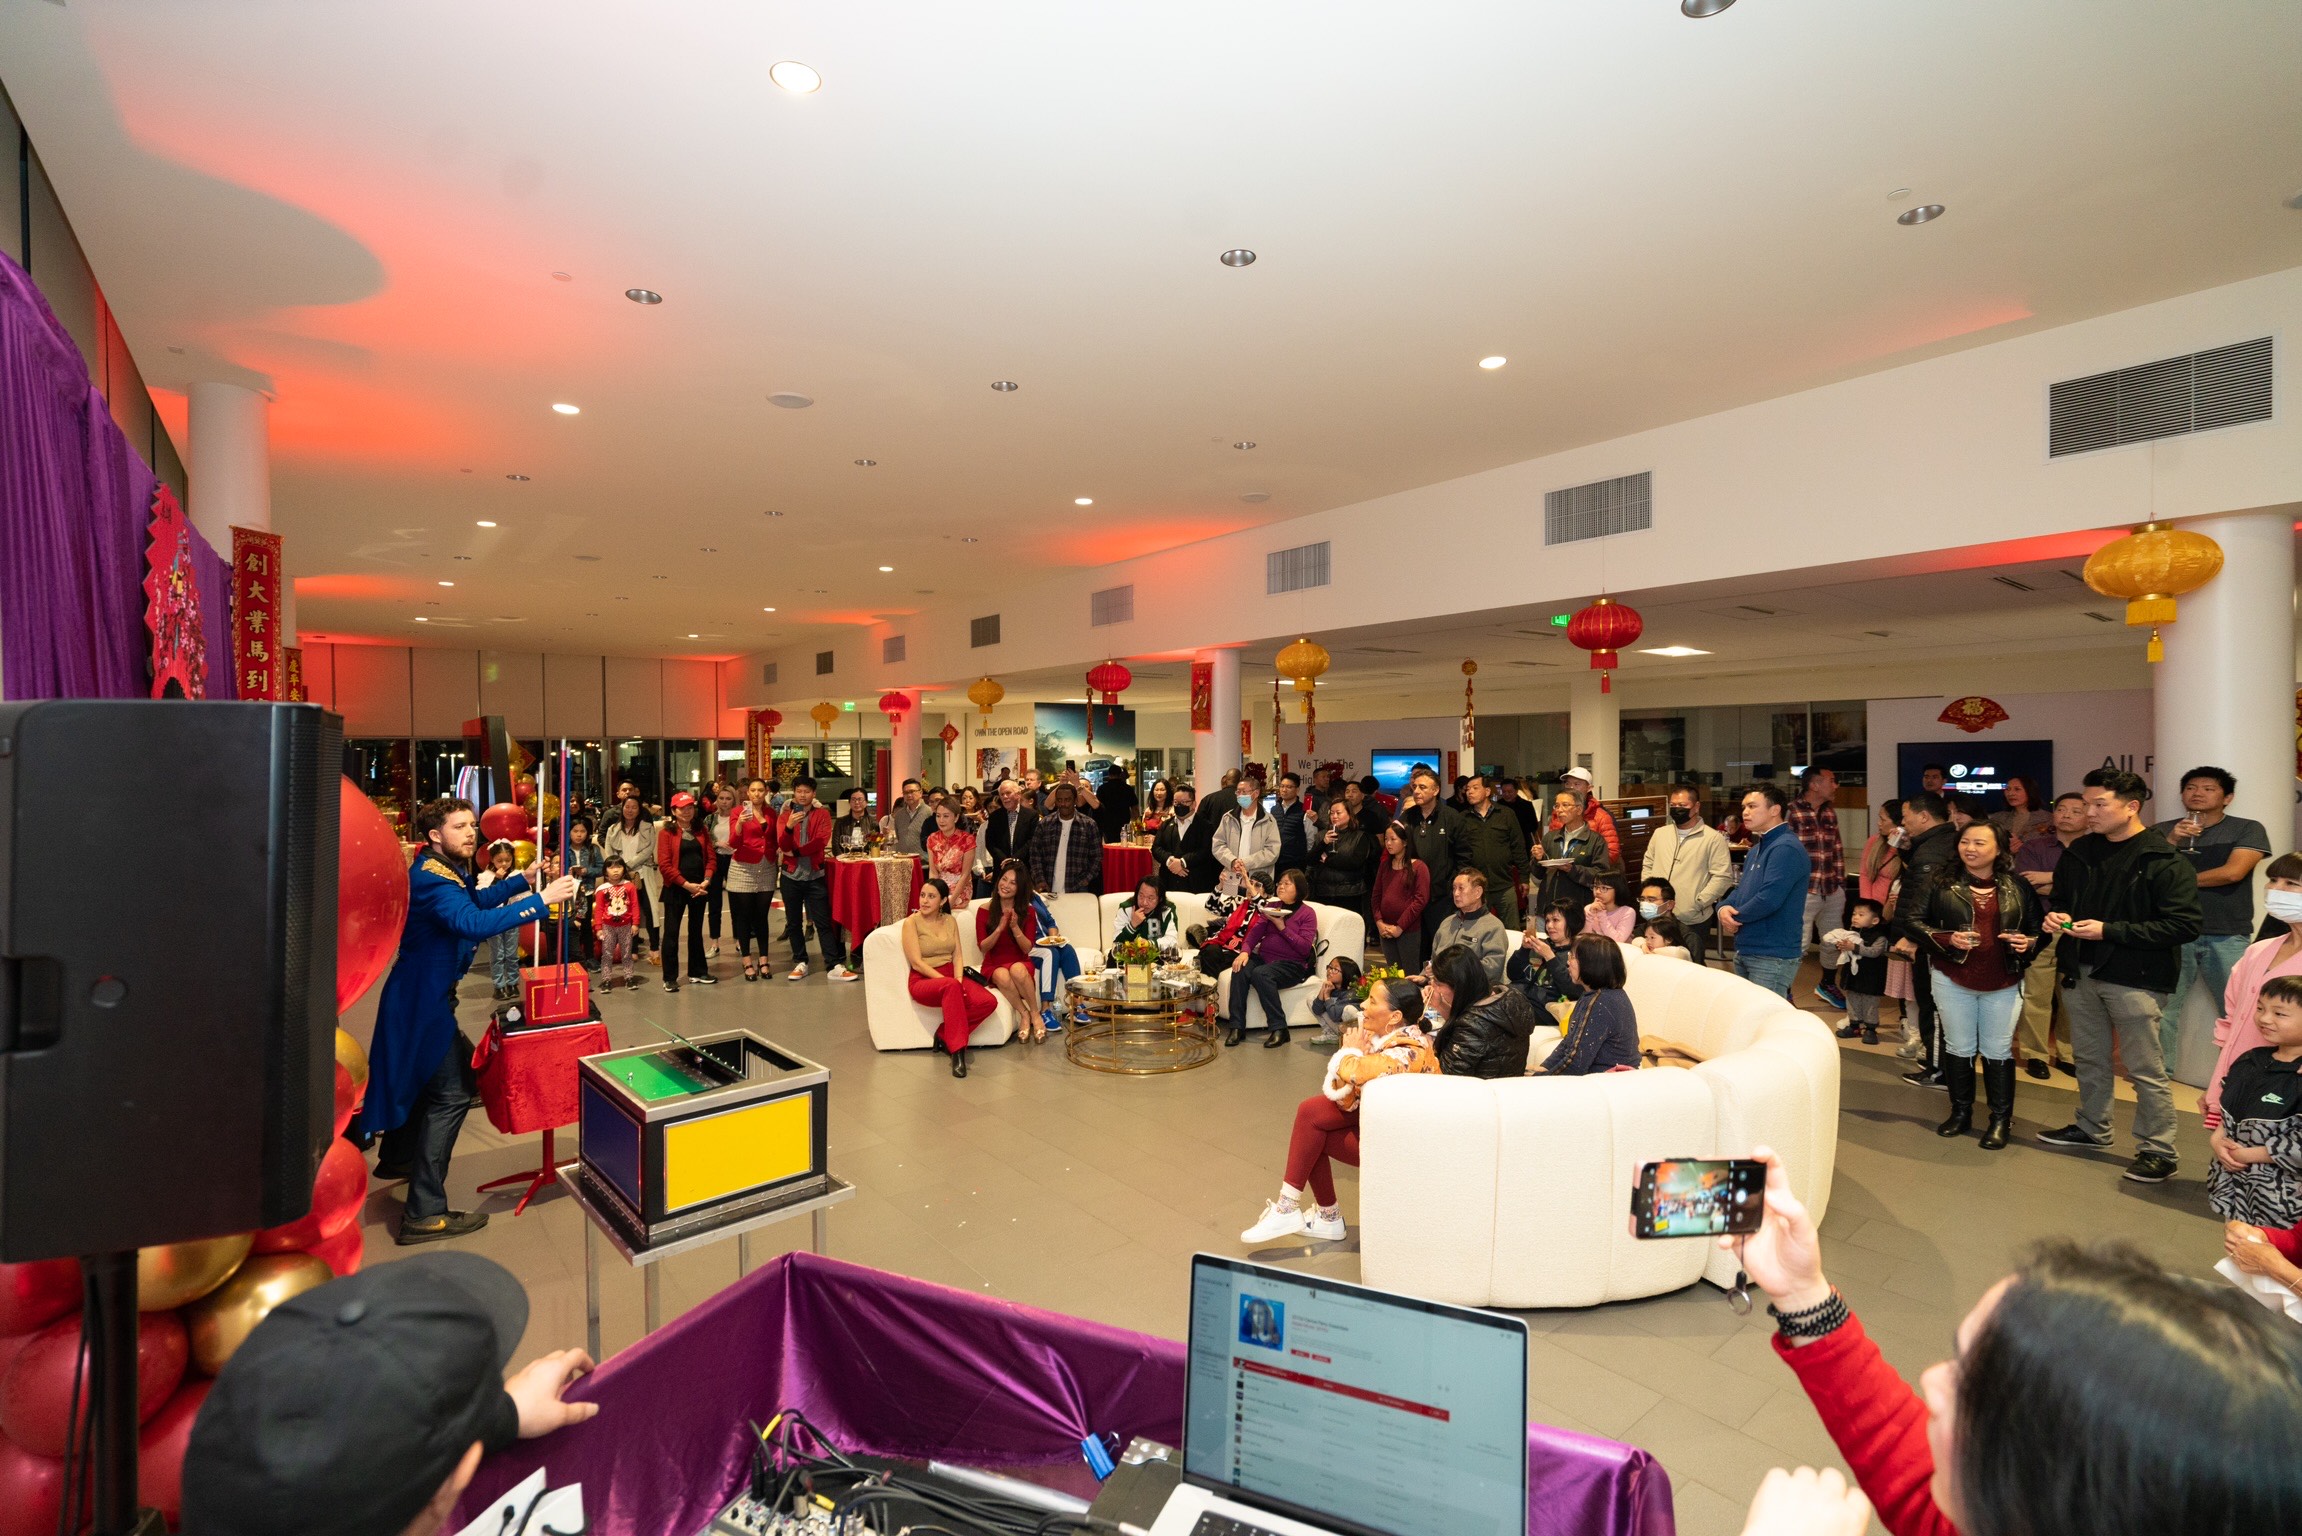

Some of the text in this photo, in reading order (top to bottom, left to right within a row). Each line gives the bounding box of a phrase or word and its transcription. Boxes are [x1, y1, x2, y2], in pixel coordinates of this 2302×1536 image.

[244, 553, 270, 702] 創大業馬到
[987, 727, 997, 736] THE
[998, 726, 1012, 736] OPEN
[1013, 726, 1029, 736] ROAD
[1298, 758, 1354, 770] We Ta The
[2101, 754, 2134, 773] All
